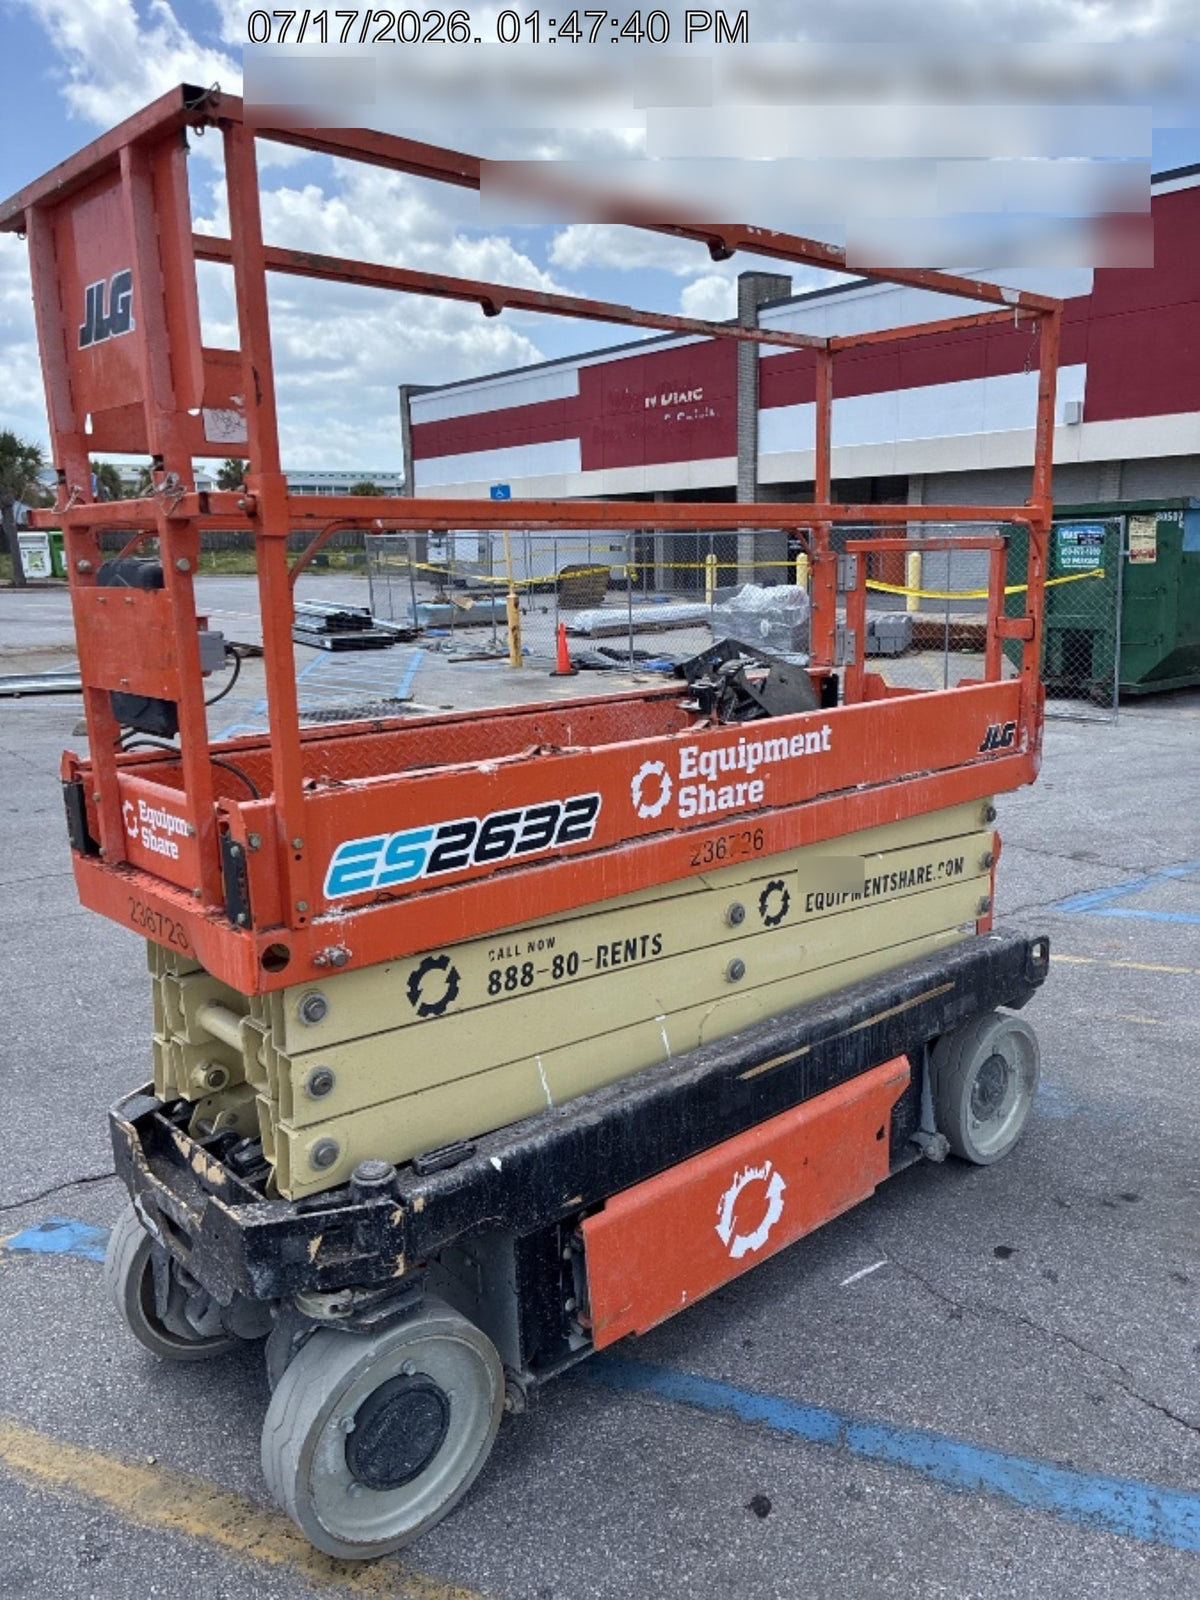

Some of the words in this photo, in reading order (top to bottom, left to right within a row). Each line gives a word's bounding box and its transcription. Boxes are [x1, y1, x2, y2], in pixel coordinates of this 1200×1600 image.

[78, 268, 135, 350] JLG
[679, 724, 833, 781] Equipment
[978, 720, 1017, 754] JLG
[678, 778, 764, 819] Share
[141, 826, 179, 860] Share
[323, 792, 602, 900] ES2632
[690, 828, 764, 867] 23626
[487, 933, 663, 996] 888-80-RENTS
[488, 944, 521, 962] CALL
[527, 936, 556, 954] NOW
